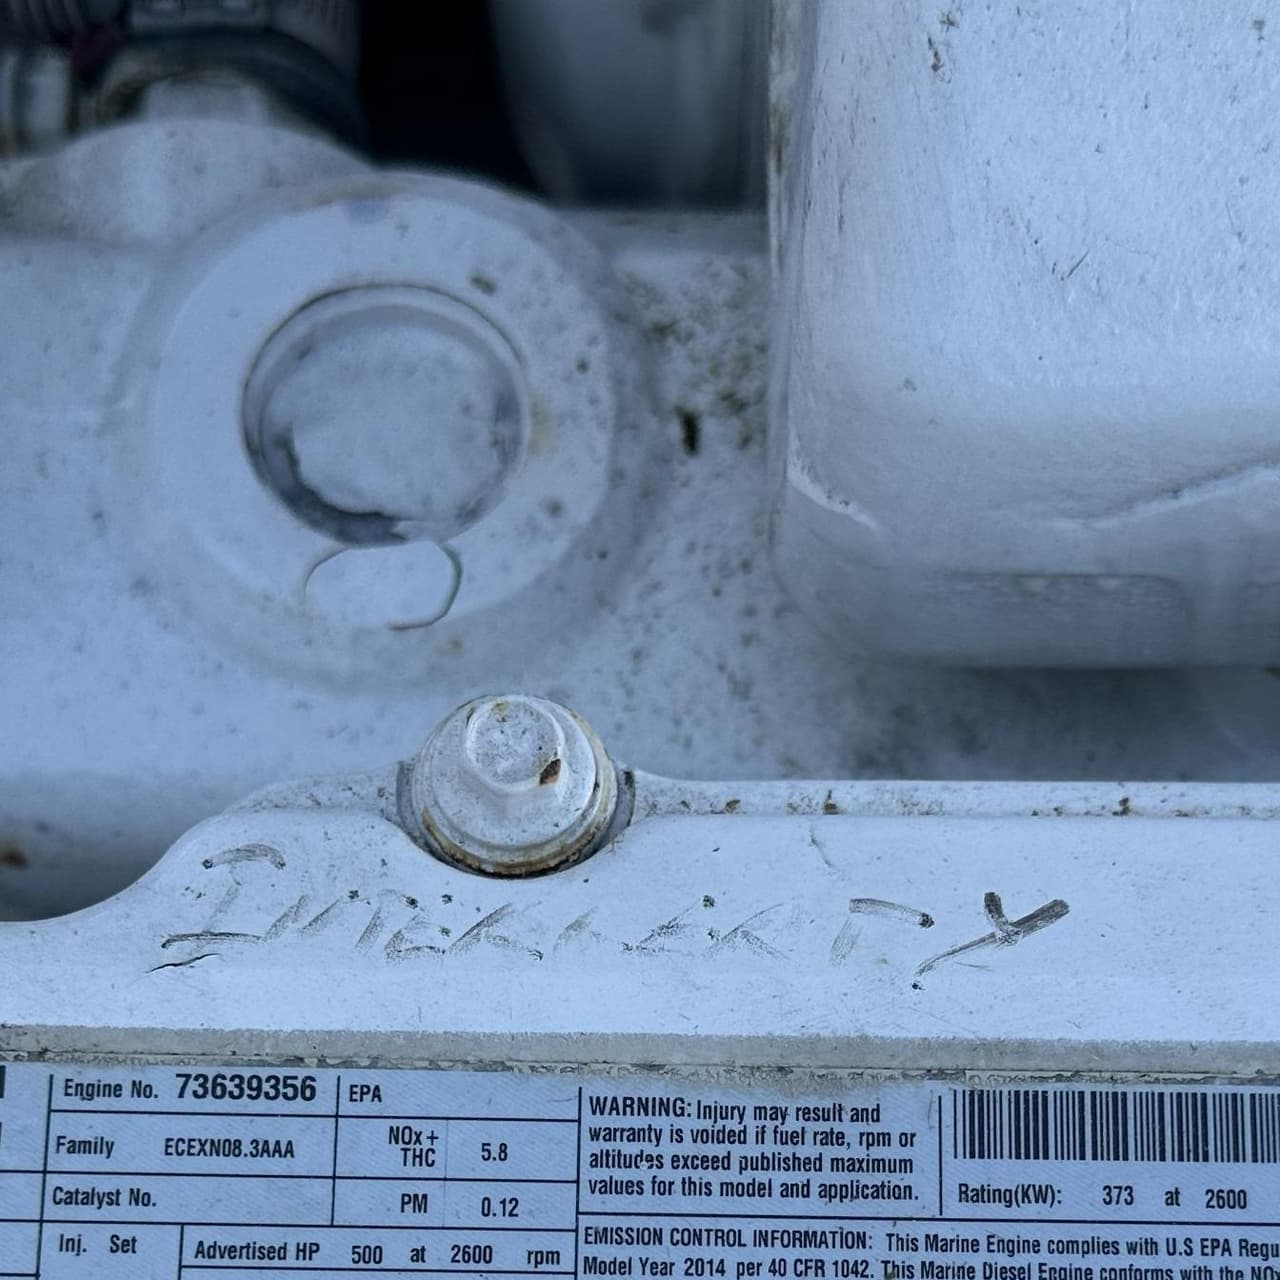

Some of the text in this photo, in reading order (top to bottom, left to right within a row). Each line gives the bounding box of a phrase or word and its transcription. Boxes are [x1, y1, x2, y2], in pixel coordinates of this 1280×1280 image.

[64, 1073, 316, 1102] Engine No. 73639356
[349, 1084, 382, 1103] EPA
[589, 1096, 880, 1128] WARNING: Injury may result and
[56, 1135, 295, 1159] Family ECEXN08.3AAA
[589, 1124, 917, 1151] warranty is voided if fuel rate, rpm or
[400, 1147, 436, 1167] THC
[481, 1142, 508, 1162] 5.8
[671, 1150, 913, 1176] exceed published maximum
[52, 1186, 157, 1210] Catalyst No.
[588, 1175, 810, 1198] values for this model and
[958, 1183, 1062, 1208] Rating(KW):
[1102, 1185, 1134, 1206] 373
[1164, 1187, 1181, 1207] at
[1205, 1189, 1247, 1210] 2600
[400, 1193, 428, 1214] PM
[481, 1197, 519, 1217] 0.12
[59, 1233, 138, 1256] Inj. Set
[584, 1226, 663, 1246] EMISSION
[670, 1227, 747, 1248] CONTROL
[885, 1233, 919, 1252] This
[925, 1234, 980, 1253] Marine
[986, 1234, 1041, 1258] Engine
[1047, 1236, 1120, 1258] complies
[1126, 1237, 1158, 1256] with
[1166, 1237, 1194, 1256] U.S
[1200, 1238, 1232, 1257] EPA
[194, 1240, 560, 1269] Advertised HP 500 at 2600 rpm
[583, 1256, 632, 1276] Model
[639, 1257, 675, 1276] Year
[684, 1257, 726, 1277] 2014
[736, 1261, 763, 1280] per
[768, 1258, 787, 1277] 40
[793, 1258, 825, 1278] CFR
[832, 1259, 874, 1279] 1042.
[983, 1261, 1031, 1280] Diesel
